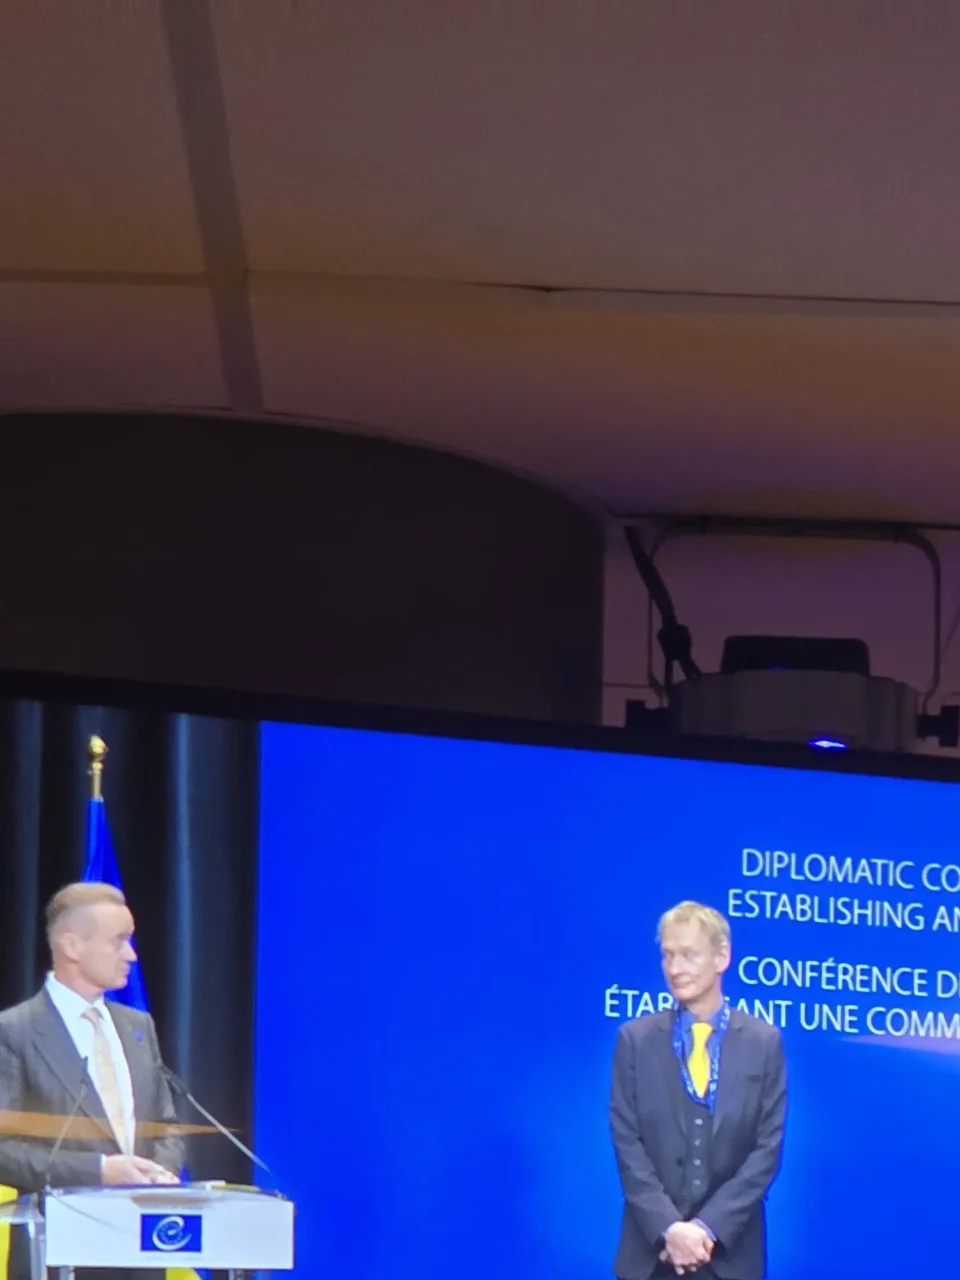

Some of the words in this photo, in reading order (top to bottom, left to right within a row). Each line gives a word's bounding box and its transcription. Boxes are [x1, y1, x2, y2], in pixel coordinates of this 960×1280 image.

[741, 848, 915, 890] DIPLOMATIC
[728, 888, 925, 931] ESTABLISHING
[737, 955, 929, 997] CONFÉRENCE
[604, 983, 793, 1028] ÉTABANT
[799, 1002, 860, 1034] UNE
